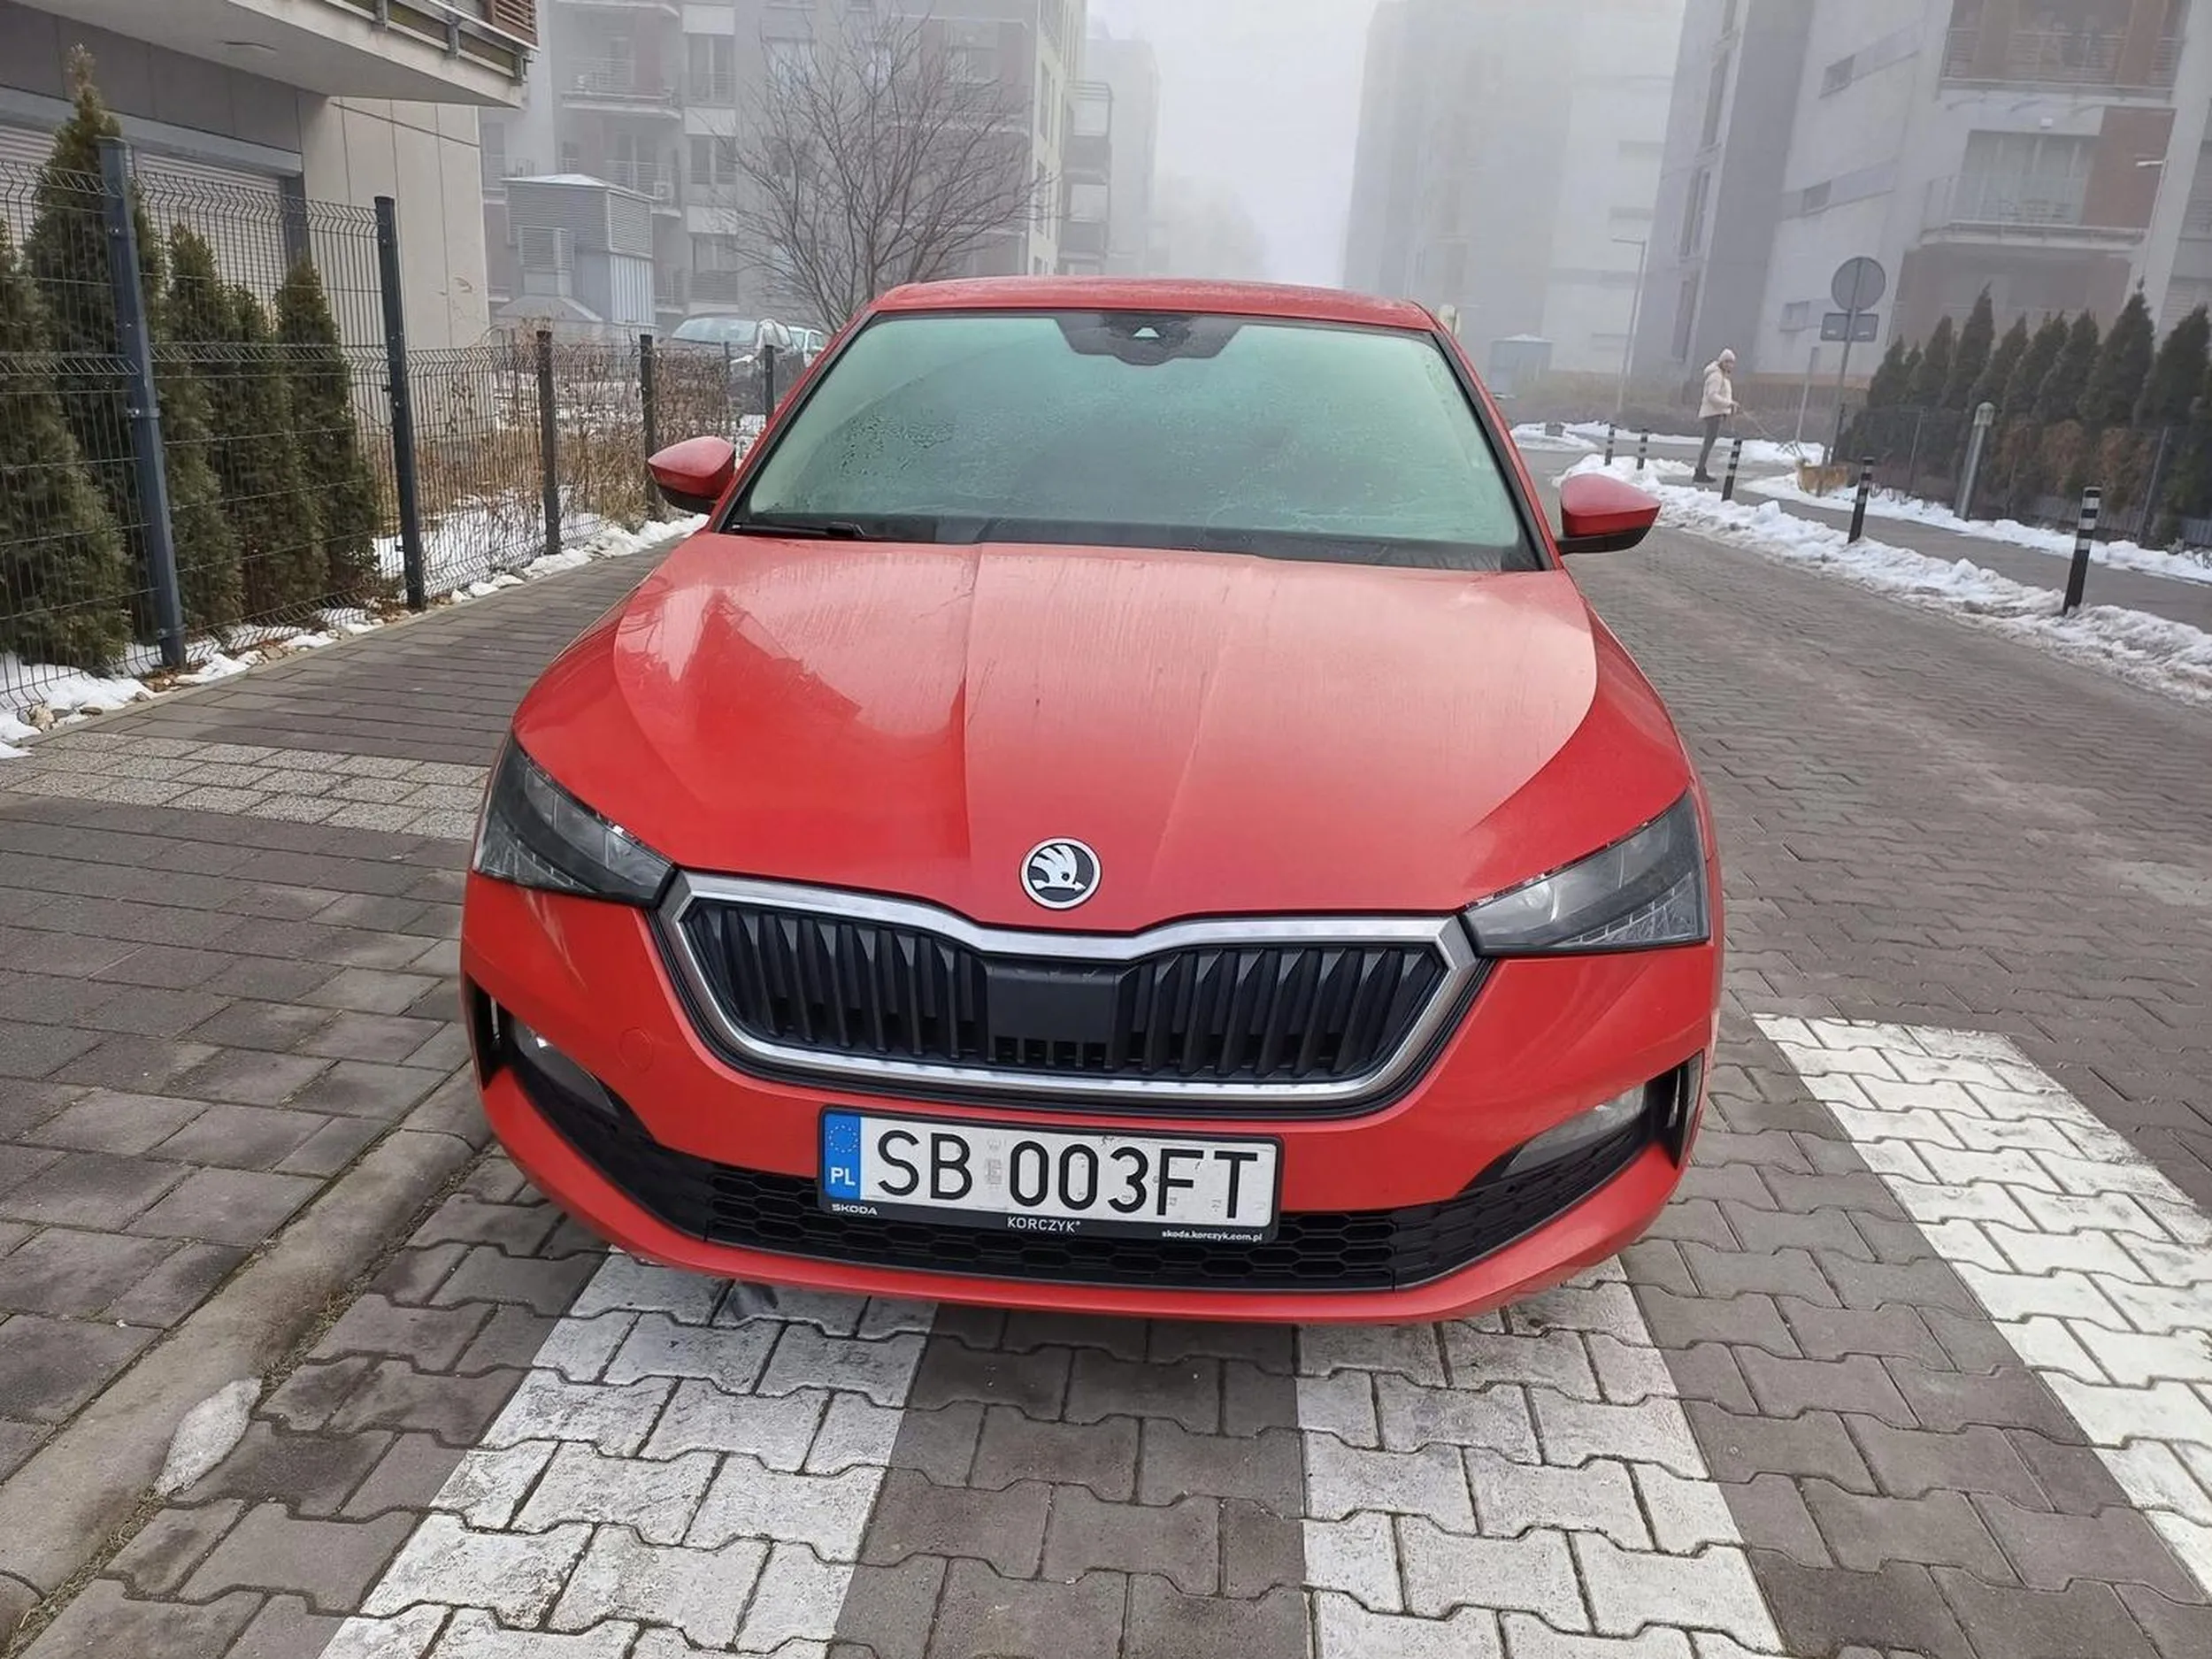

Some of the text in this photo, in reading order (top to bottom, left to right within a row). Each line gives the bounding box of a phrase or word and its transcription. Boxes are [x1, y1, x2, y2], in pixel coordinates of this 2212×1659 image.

[830, 1167, 856, 1186] PL
[877, 1130, 1258, 1218] SB 003FT
[1162, 1230, 1263, 1242] skoda.korczyk.com.pl
